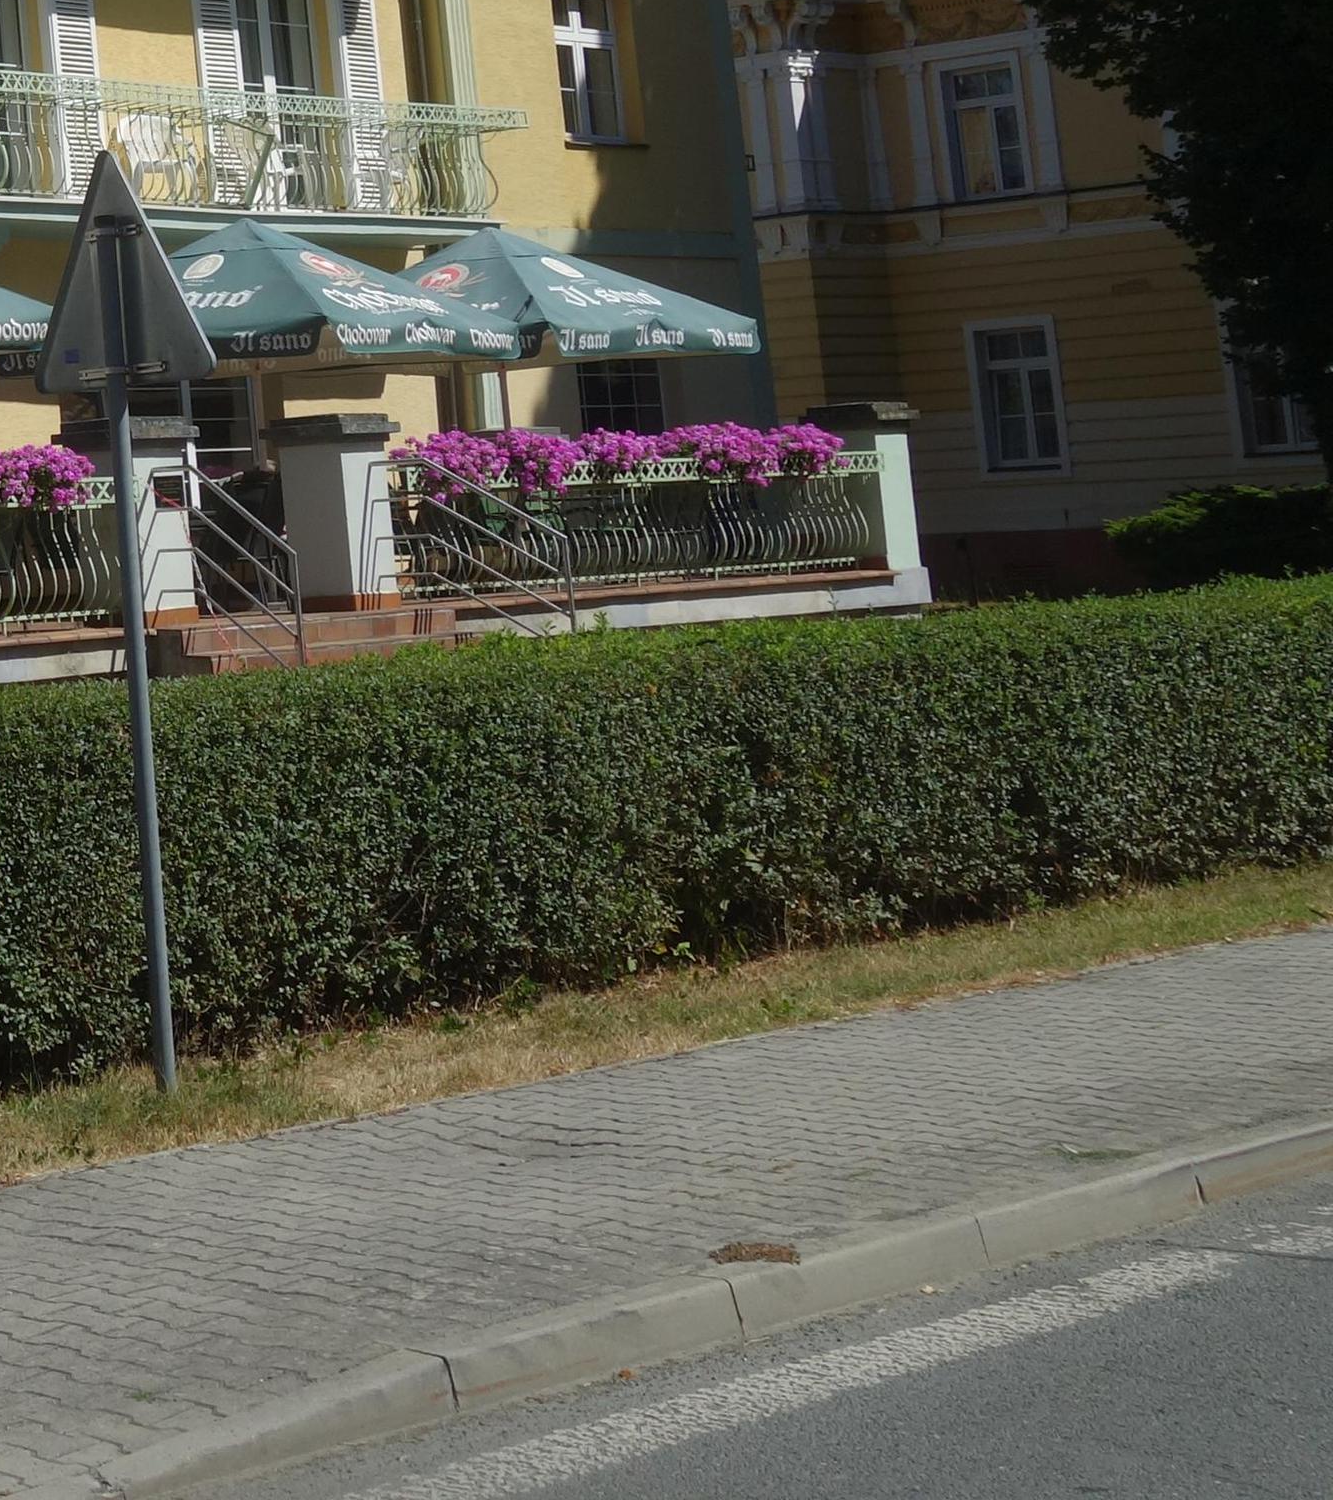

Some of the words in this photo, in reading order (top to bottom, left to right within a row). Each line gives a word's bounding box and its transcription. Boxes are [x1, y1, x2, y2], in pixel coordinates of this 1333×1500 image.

[183, 288, 255, 310] ano
[336, 323, 392, 346] Chodovar
[404, 321, 456, 345] Chodovar
[470, 327, 515, 351] Chodovar
[578, 330, 611, 349] sano
[652, 326, 685, 346] sano
[726, 330, 755, 348] sano
